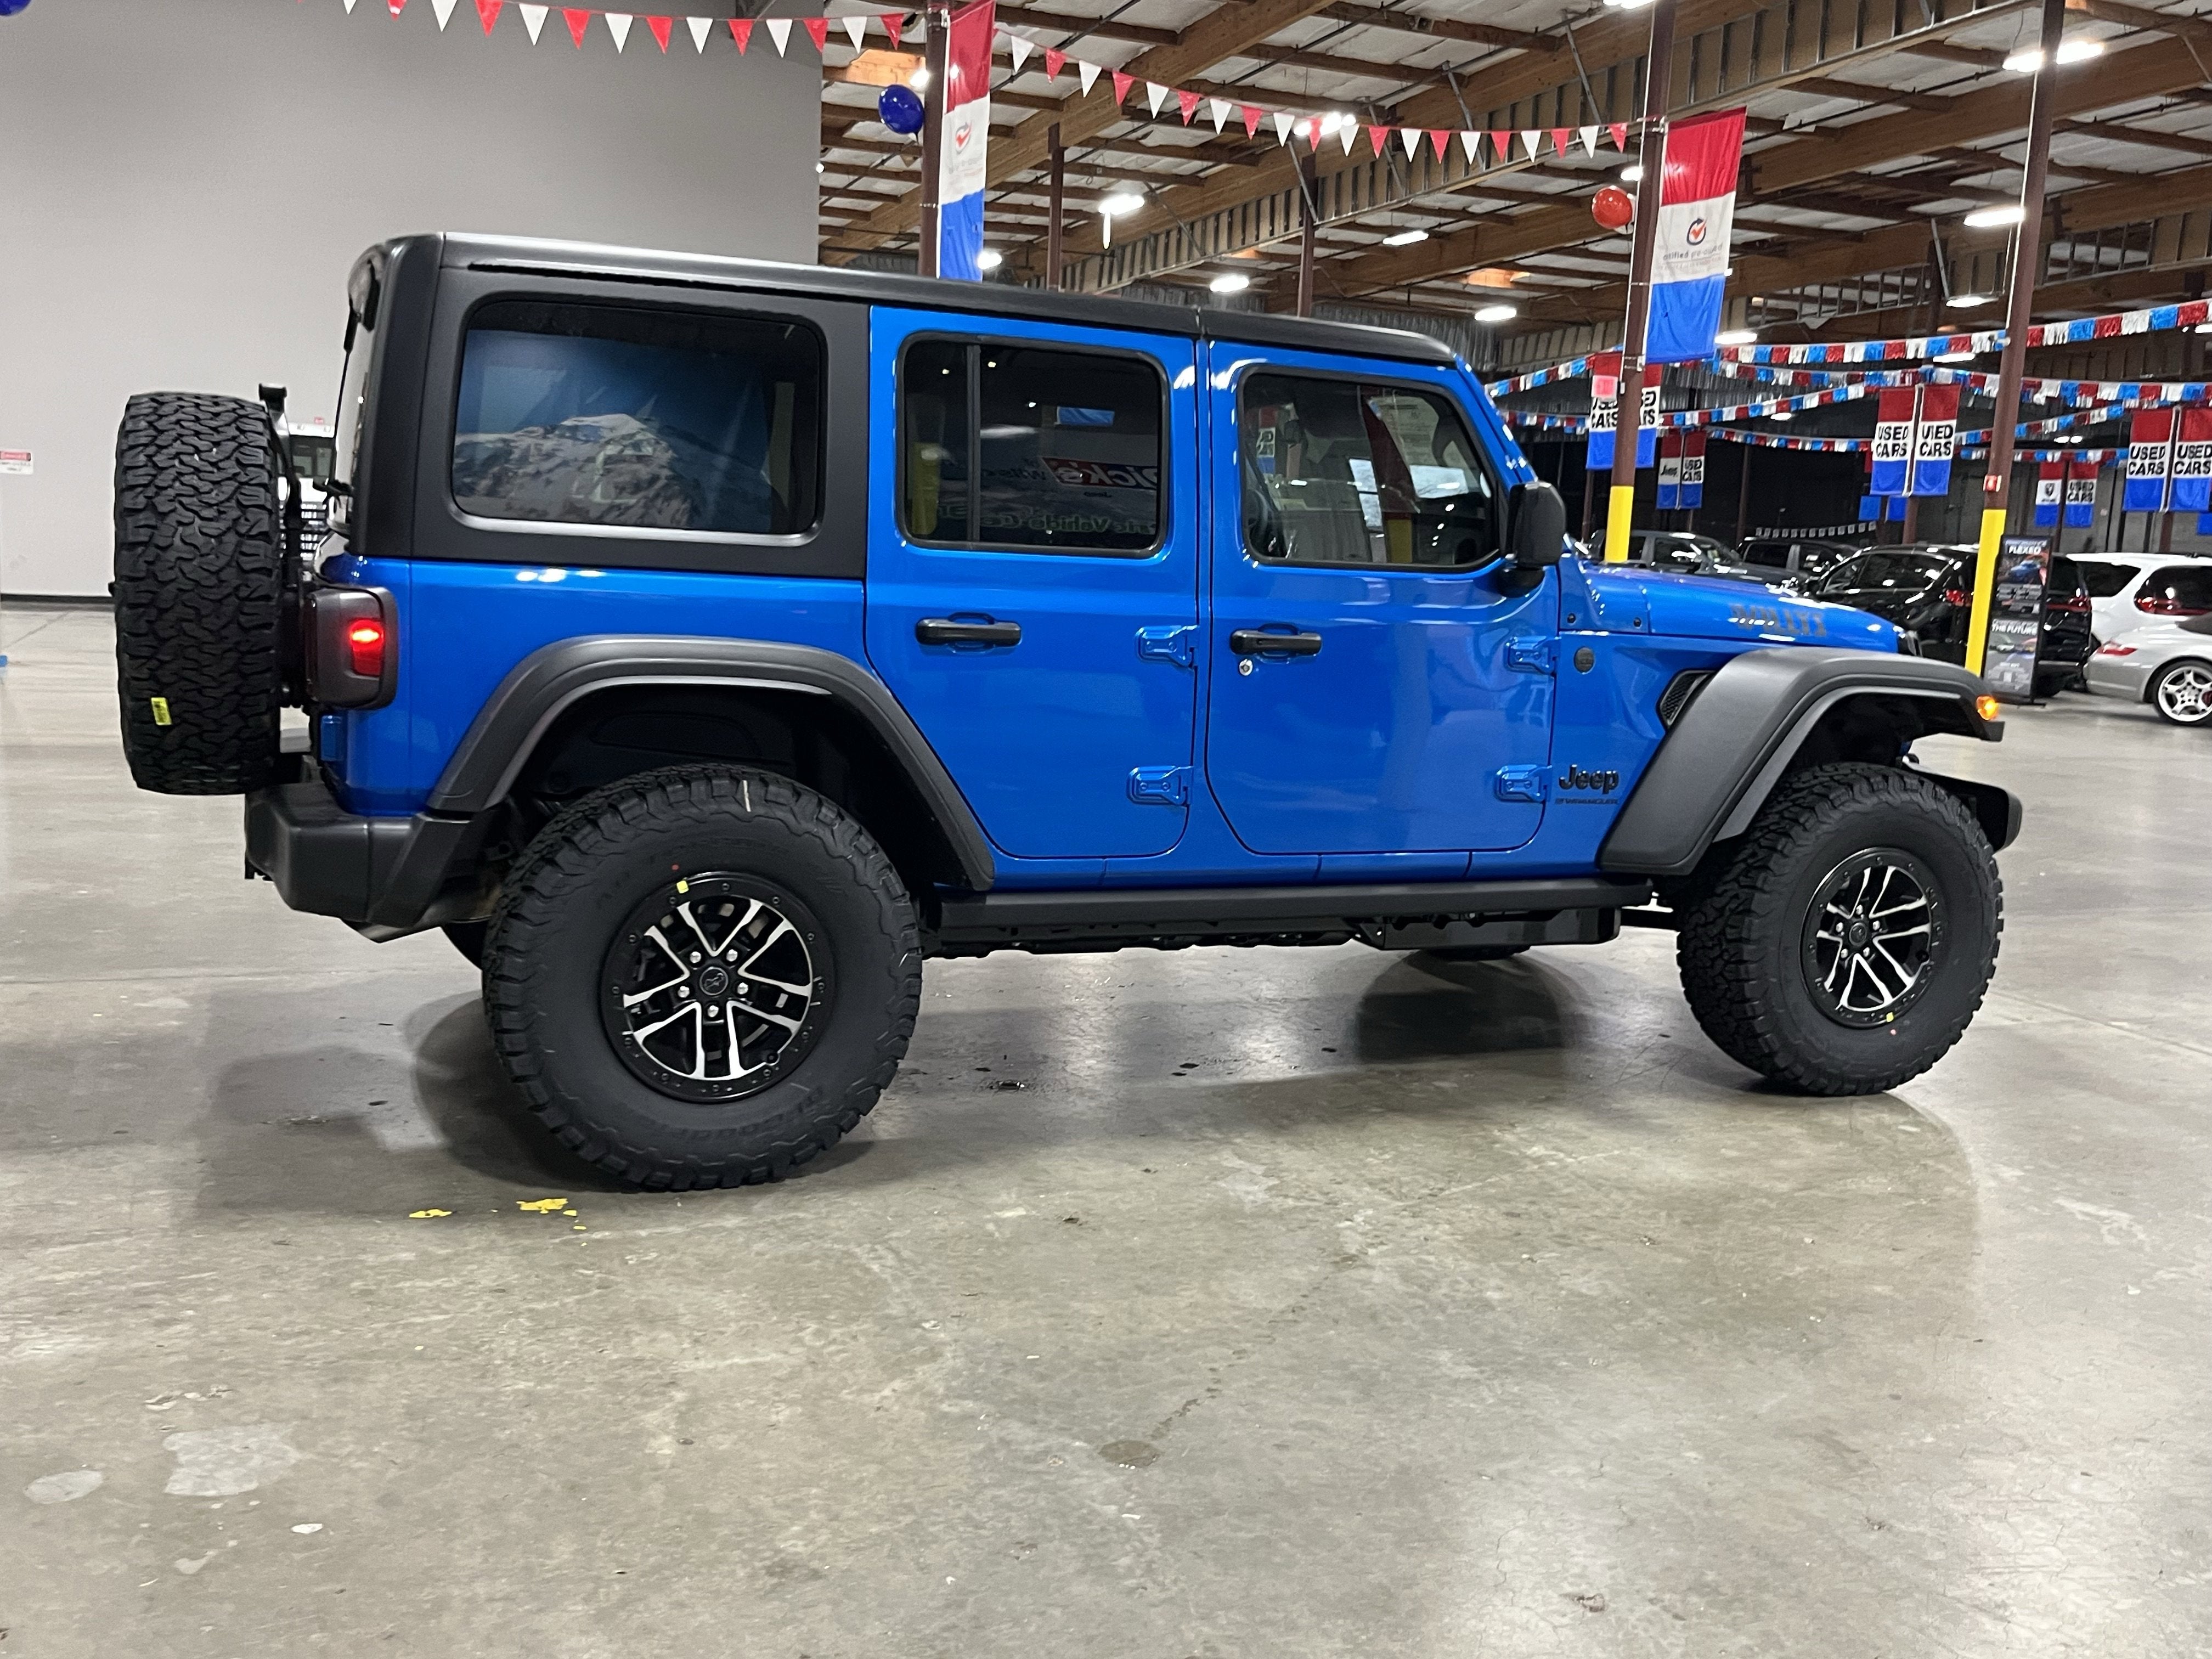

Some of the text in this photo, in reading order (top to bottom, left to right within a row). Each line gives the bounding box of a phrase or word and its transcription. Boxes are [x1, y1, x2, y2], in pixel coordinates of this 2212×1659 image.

[1878, 425, 1909, 441] USED
[1876, 442, 1908, 458] CARS
[2130, 445, 2166, 460] USED
[2176, 444, 2212, 459] USED
[2128, 461, 2165, 476] CARS
[2173, 460, 2212, 475] CARS
[1559, 764, 1620, 795] Jeep
